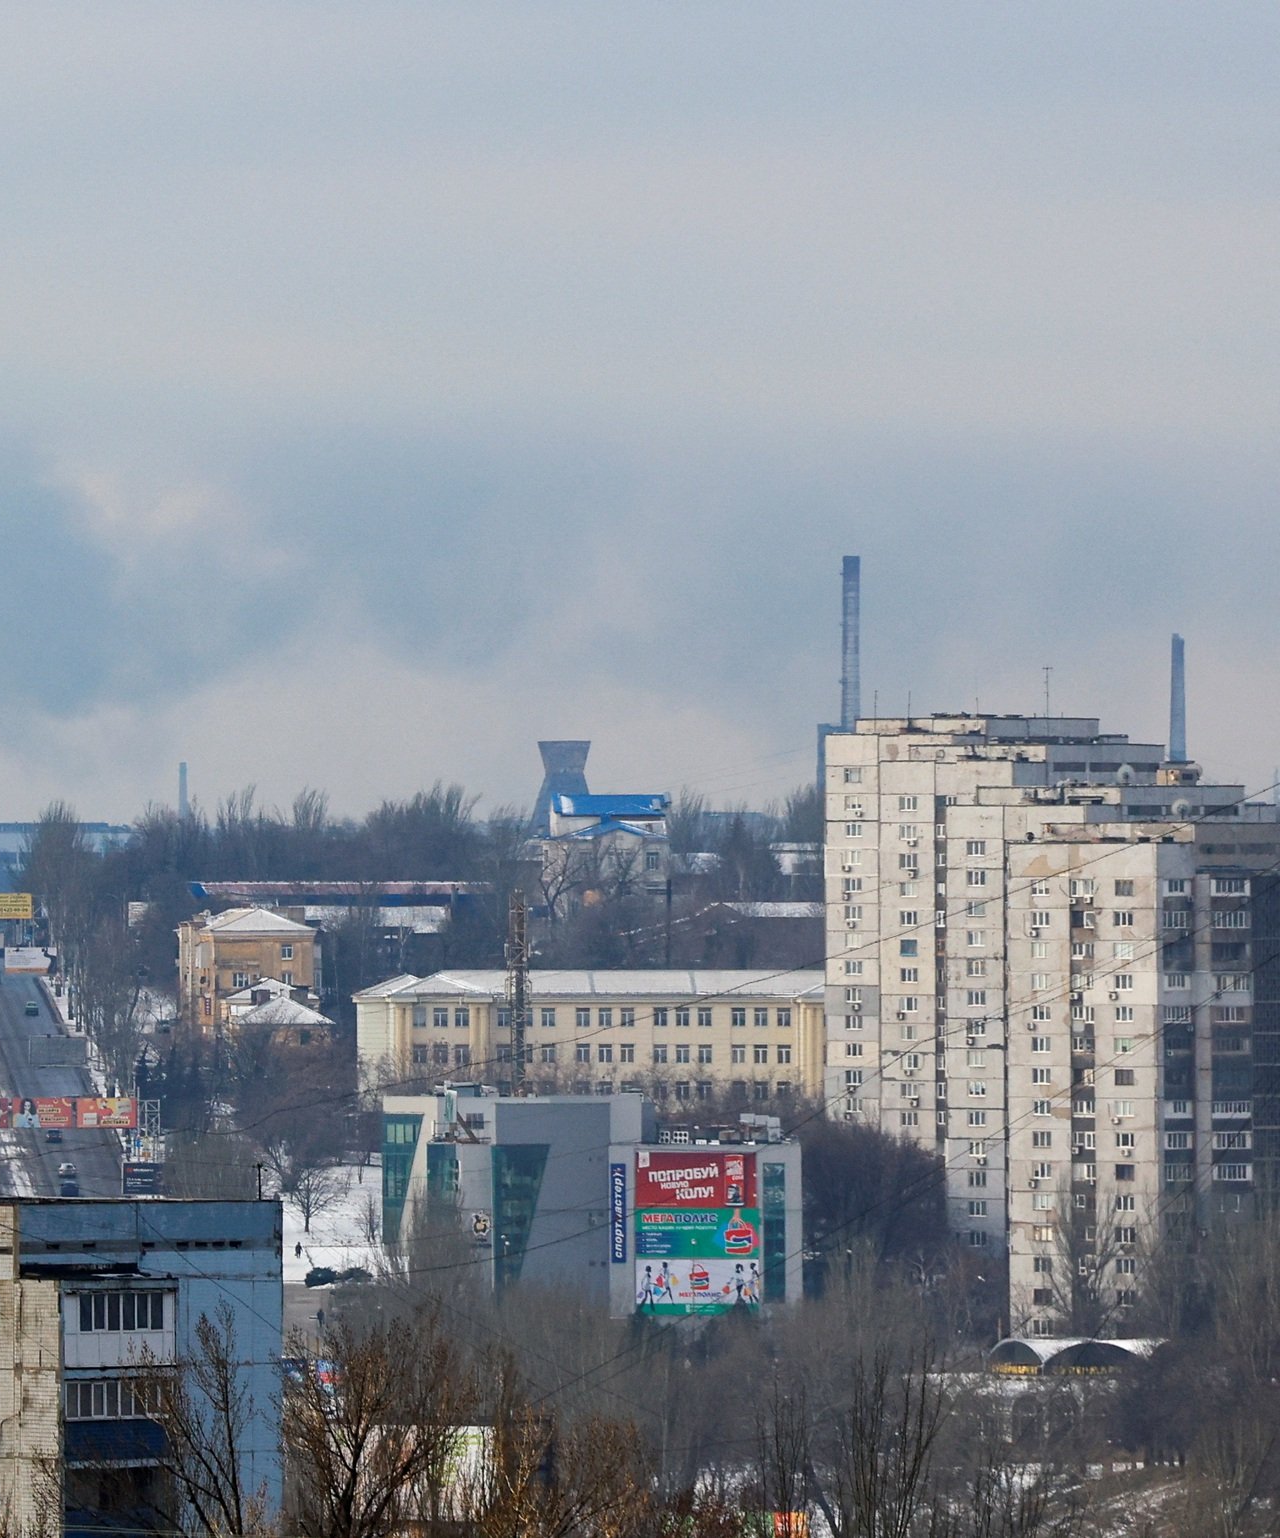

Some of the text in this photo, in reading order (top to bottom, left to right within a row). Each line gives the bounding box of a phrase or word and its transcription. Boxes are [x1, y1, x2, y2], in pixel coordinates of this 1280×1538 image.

[648, 1163, 719, 1183] ПОПРОБУЙ
[660, 1181, 689, 1190] НОВУЮ
[676, 1186, 714, 1201] КОЛУ!
[642, 1213, 718, 1224] МЕГАПОЛИС
